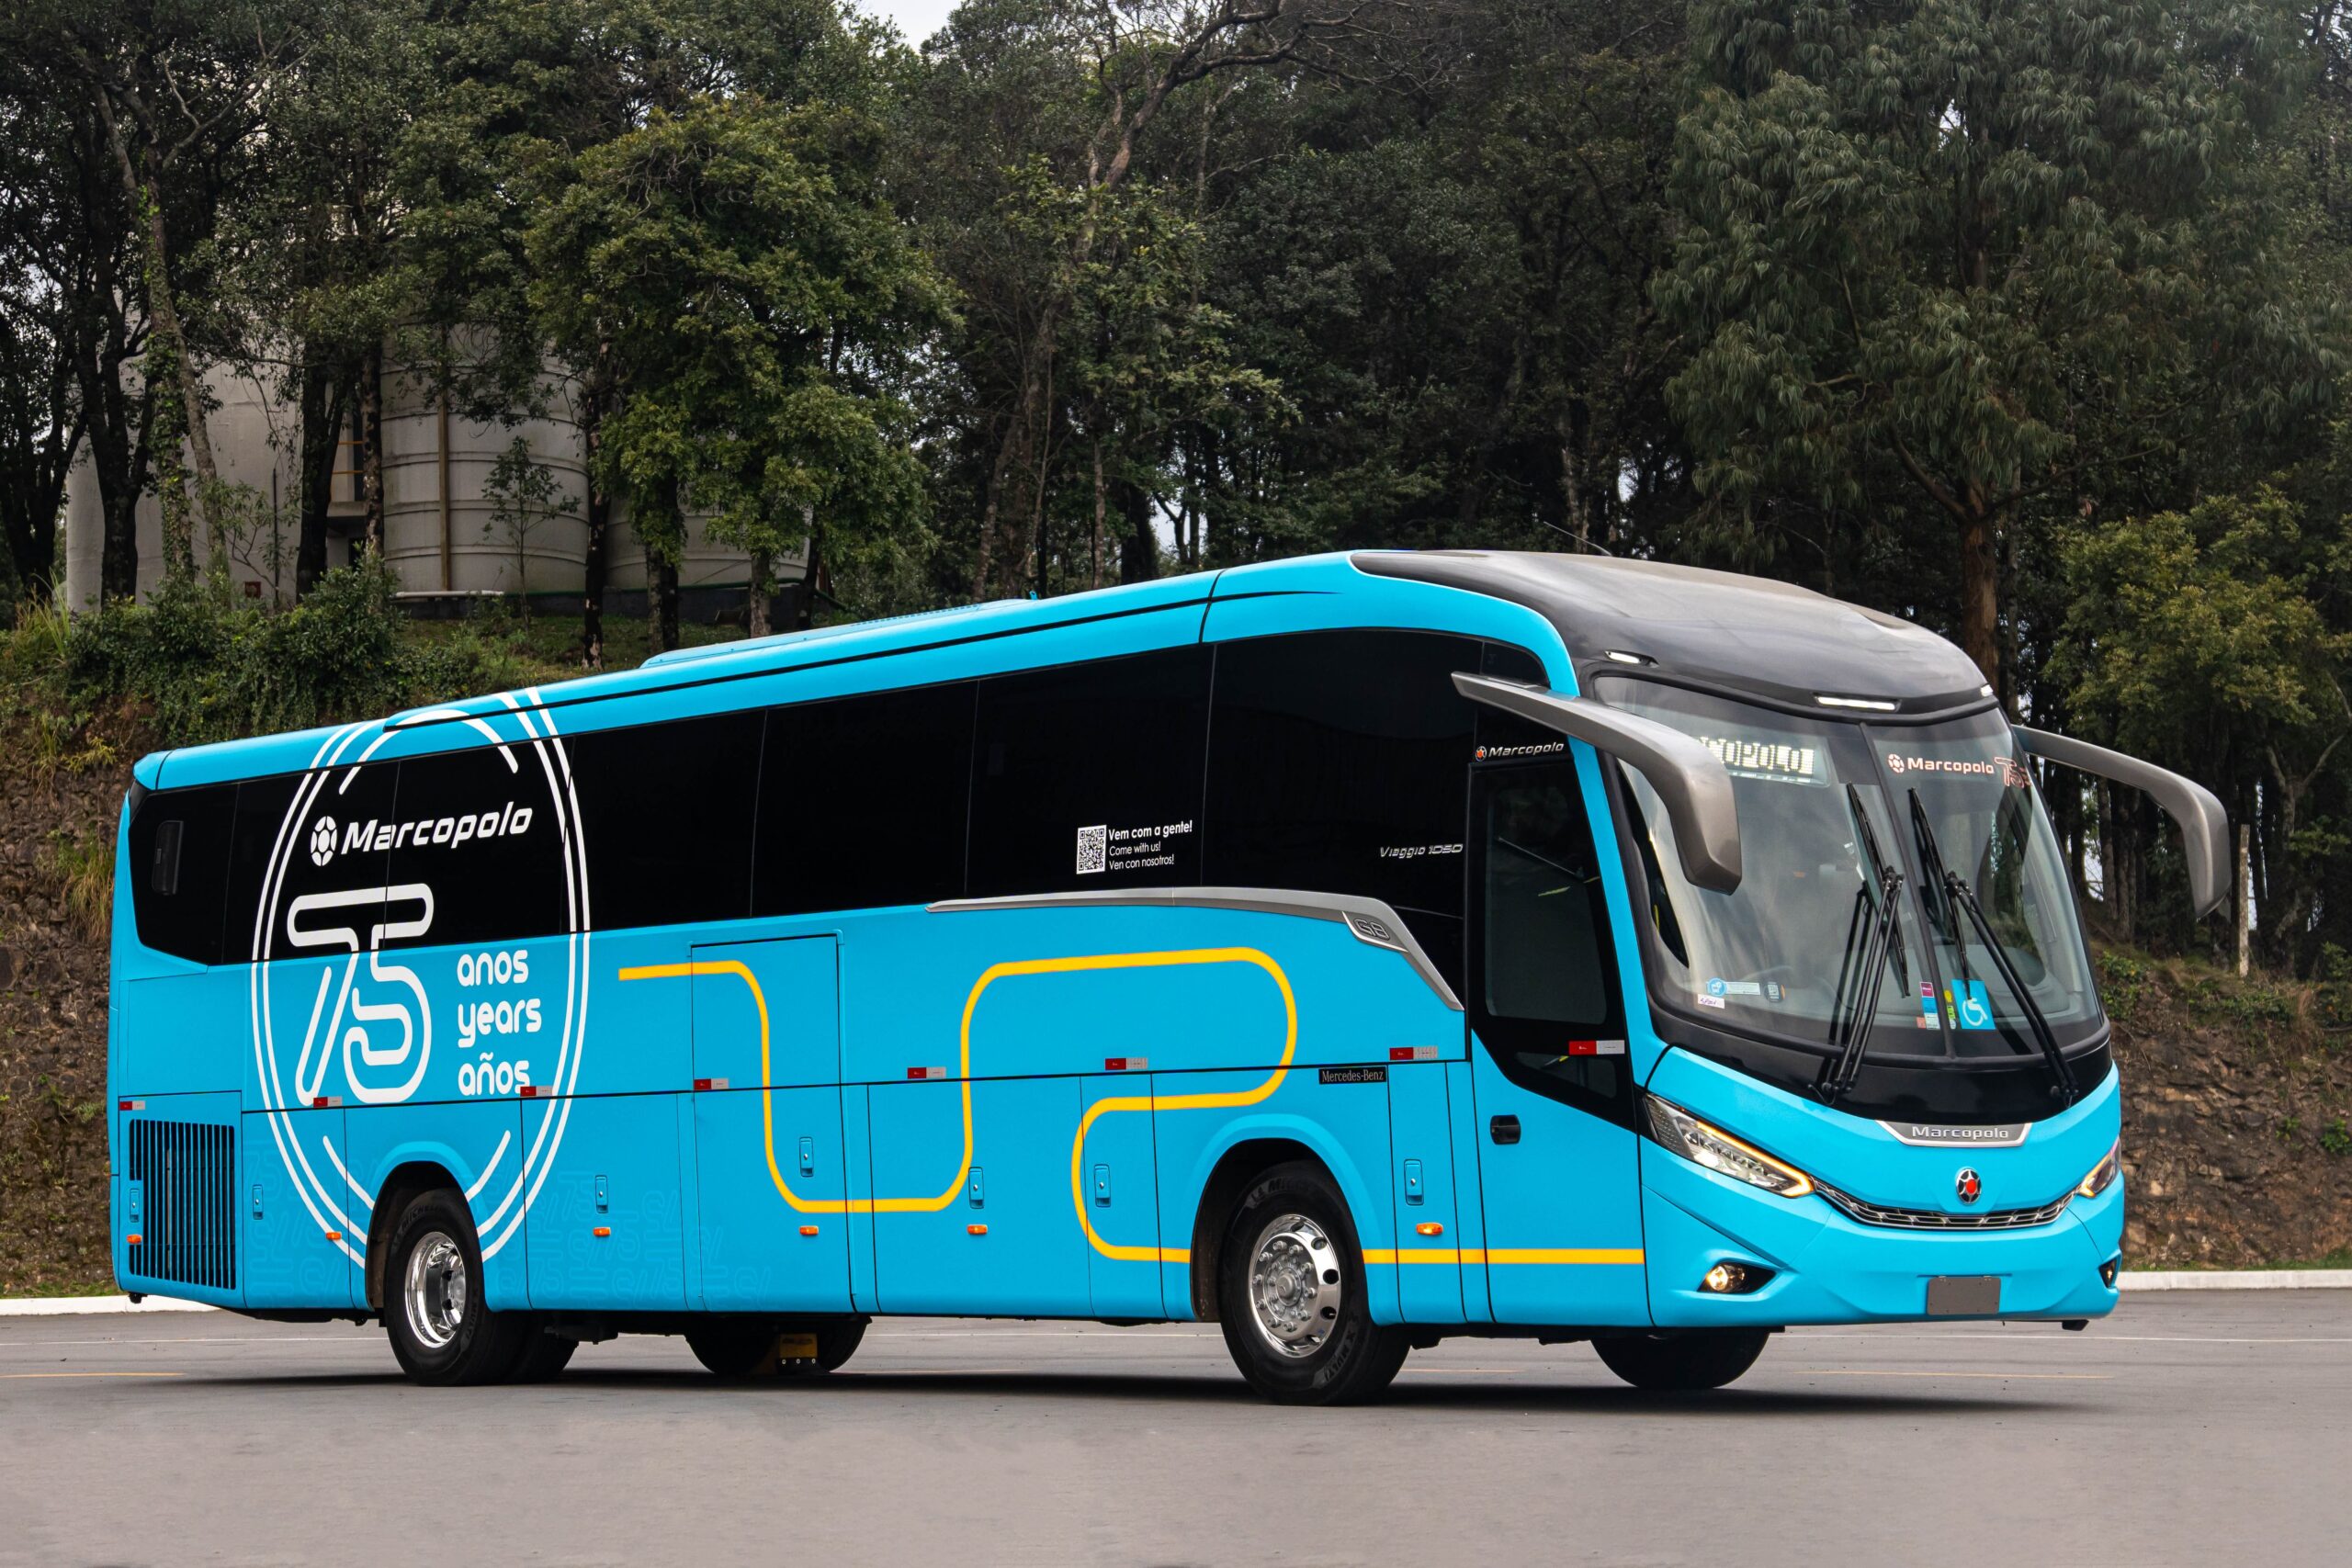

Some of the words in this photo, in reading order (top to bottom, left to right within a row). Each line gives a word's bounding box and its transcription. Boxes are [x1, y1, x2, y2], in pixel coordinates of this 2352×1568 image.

[1488, 741, 1565, 758] Marcopolo
[1907, 757, 1995, 774] Marcopolo
[341, 801, 533, 855] Marcopolo
[1108, 829, 1129, 841] Vem
[1131, 827, 1152, 839] com
[1154, 826, 1160, 837] a
[1162, 819, 1193, 838] gente!
[1109, 845, 1132, 856] Come
[1134, 842, 1149, 853] with
[1150, 840, 1161, 852] us!
[1380, 846, 1426, 859] Viaggio
[1428, 843, 1464, 855] 1050
[1109, 860, 1124, 871] Ven
[1125, 858, 1140, 869] con
[1141, 853, 1174, 867] nosotros!
[457, 949, 529, 987] anos
[287, 883, 435, 1108] 75
[458, 998, 542, 1048] years
[458, 1052, 530, 1096] años
[1321, 1068, 1385, 1083] Mercedes-Benz
[1911, 1125, 2009, 1140] Marcopolo
